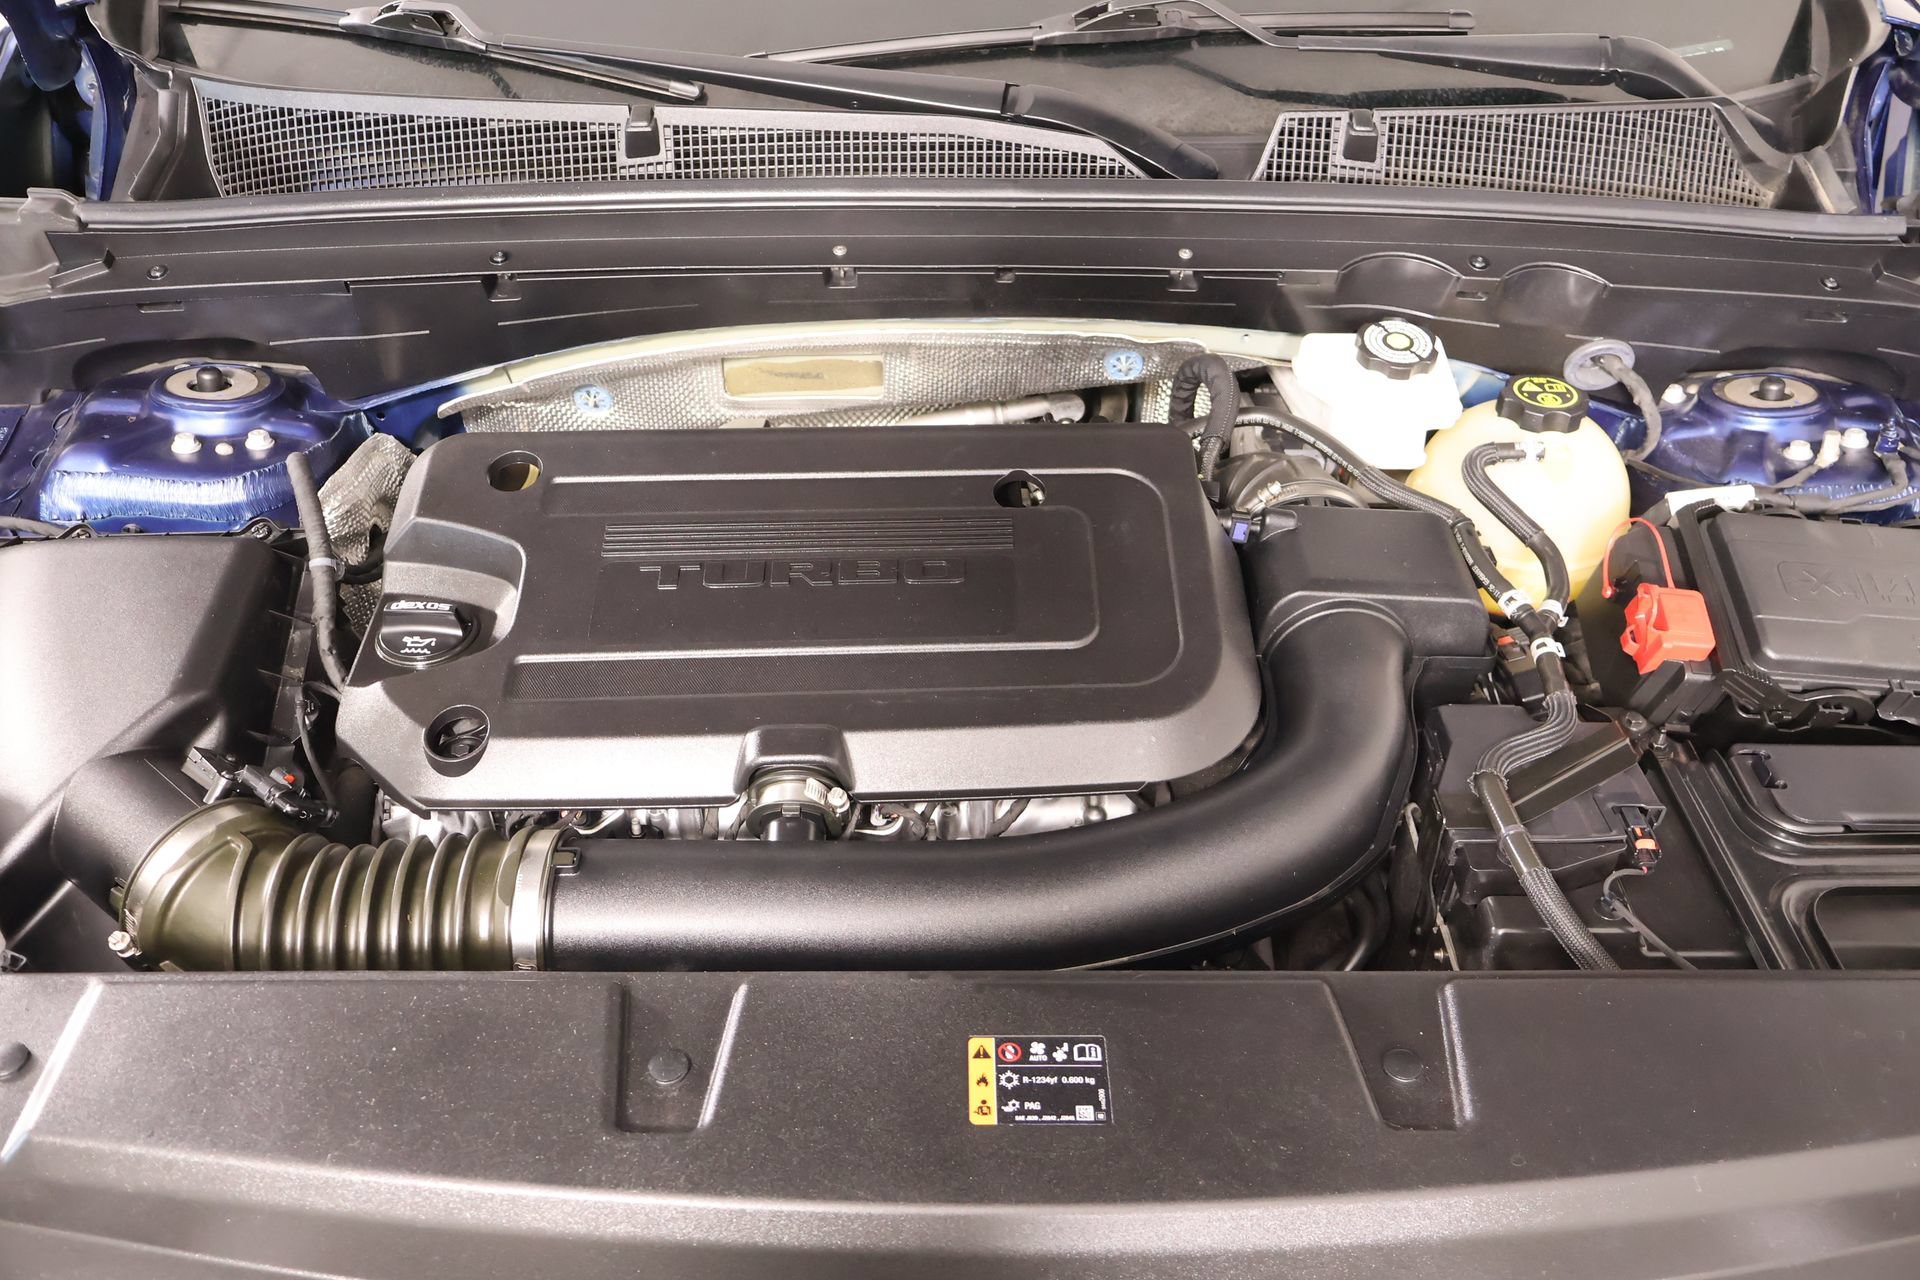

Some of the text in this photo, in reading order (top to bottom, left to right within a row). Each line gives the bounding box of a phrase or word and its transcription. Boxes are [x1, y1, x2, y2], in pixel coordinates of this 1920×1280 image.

[639, 559, 966, 590] TURBO
[390, 600, 453, 610] dexos
[1022, 1076, 1096, 1085] R-1234yf 0.600 kg
[1024, 1101, 1041, 1110] PAG
